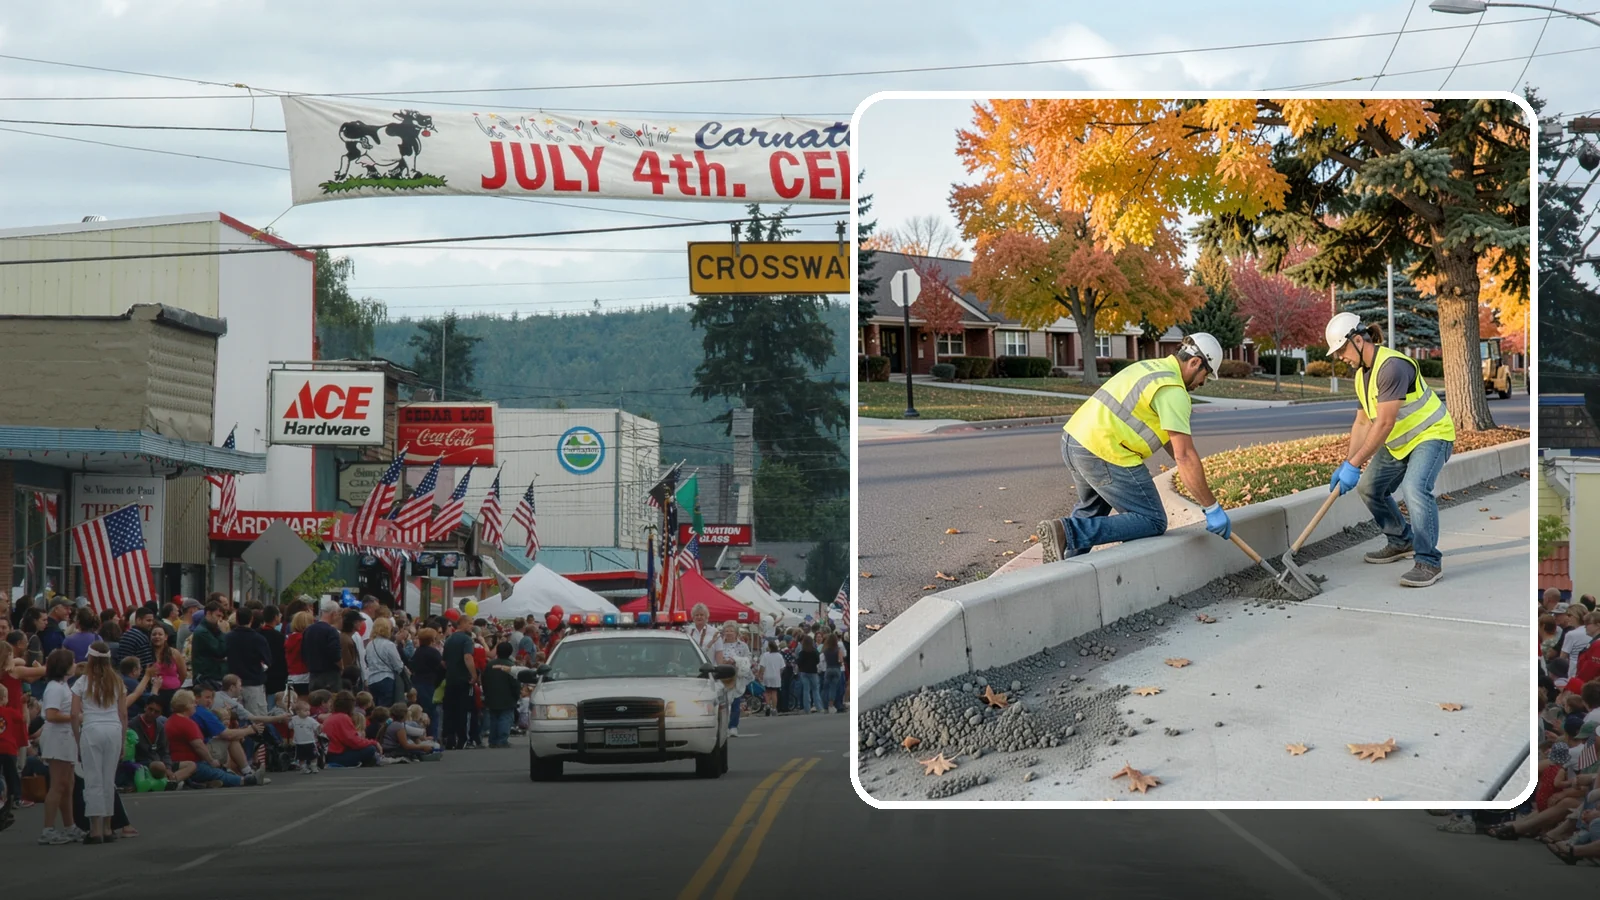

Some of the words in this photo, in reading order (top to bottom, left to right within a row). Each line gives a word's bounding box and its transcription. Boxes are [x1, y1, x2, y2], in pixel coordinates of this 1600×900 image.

[695, 121, 850, 150] Carnat
[481, 141, 605, 192] JULY
[632, 150, 746, 197] 4th.
[697, 254, 850, 280] CROSSWA
[282, 380, 373, 420] ACE
[405, 409, 452, 421] CEDAR
[461, 409, 485, 421] LOG
[283, 421, 371, 436] Hardware
[83, 485, 94, 494] St.
[95, 485, 124, 495] Vincent
[126, 486, 136, 495] de
[138, 486, 155, 495] Paul
[688, 526, 741, 535] CRNATION
[699, 535, 730, 543] GLASS
